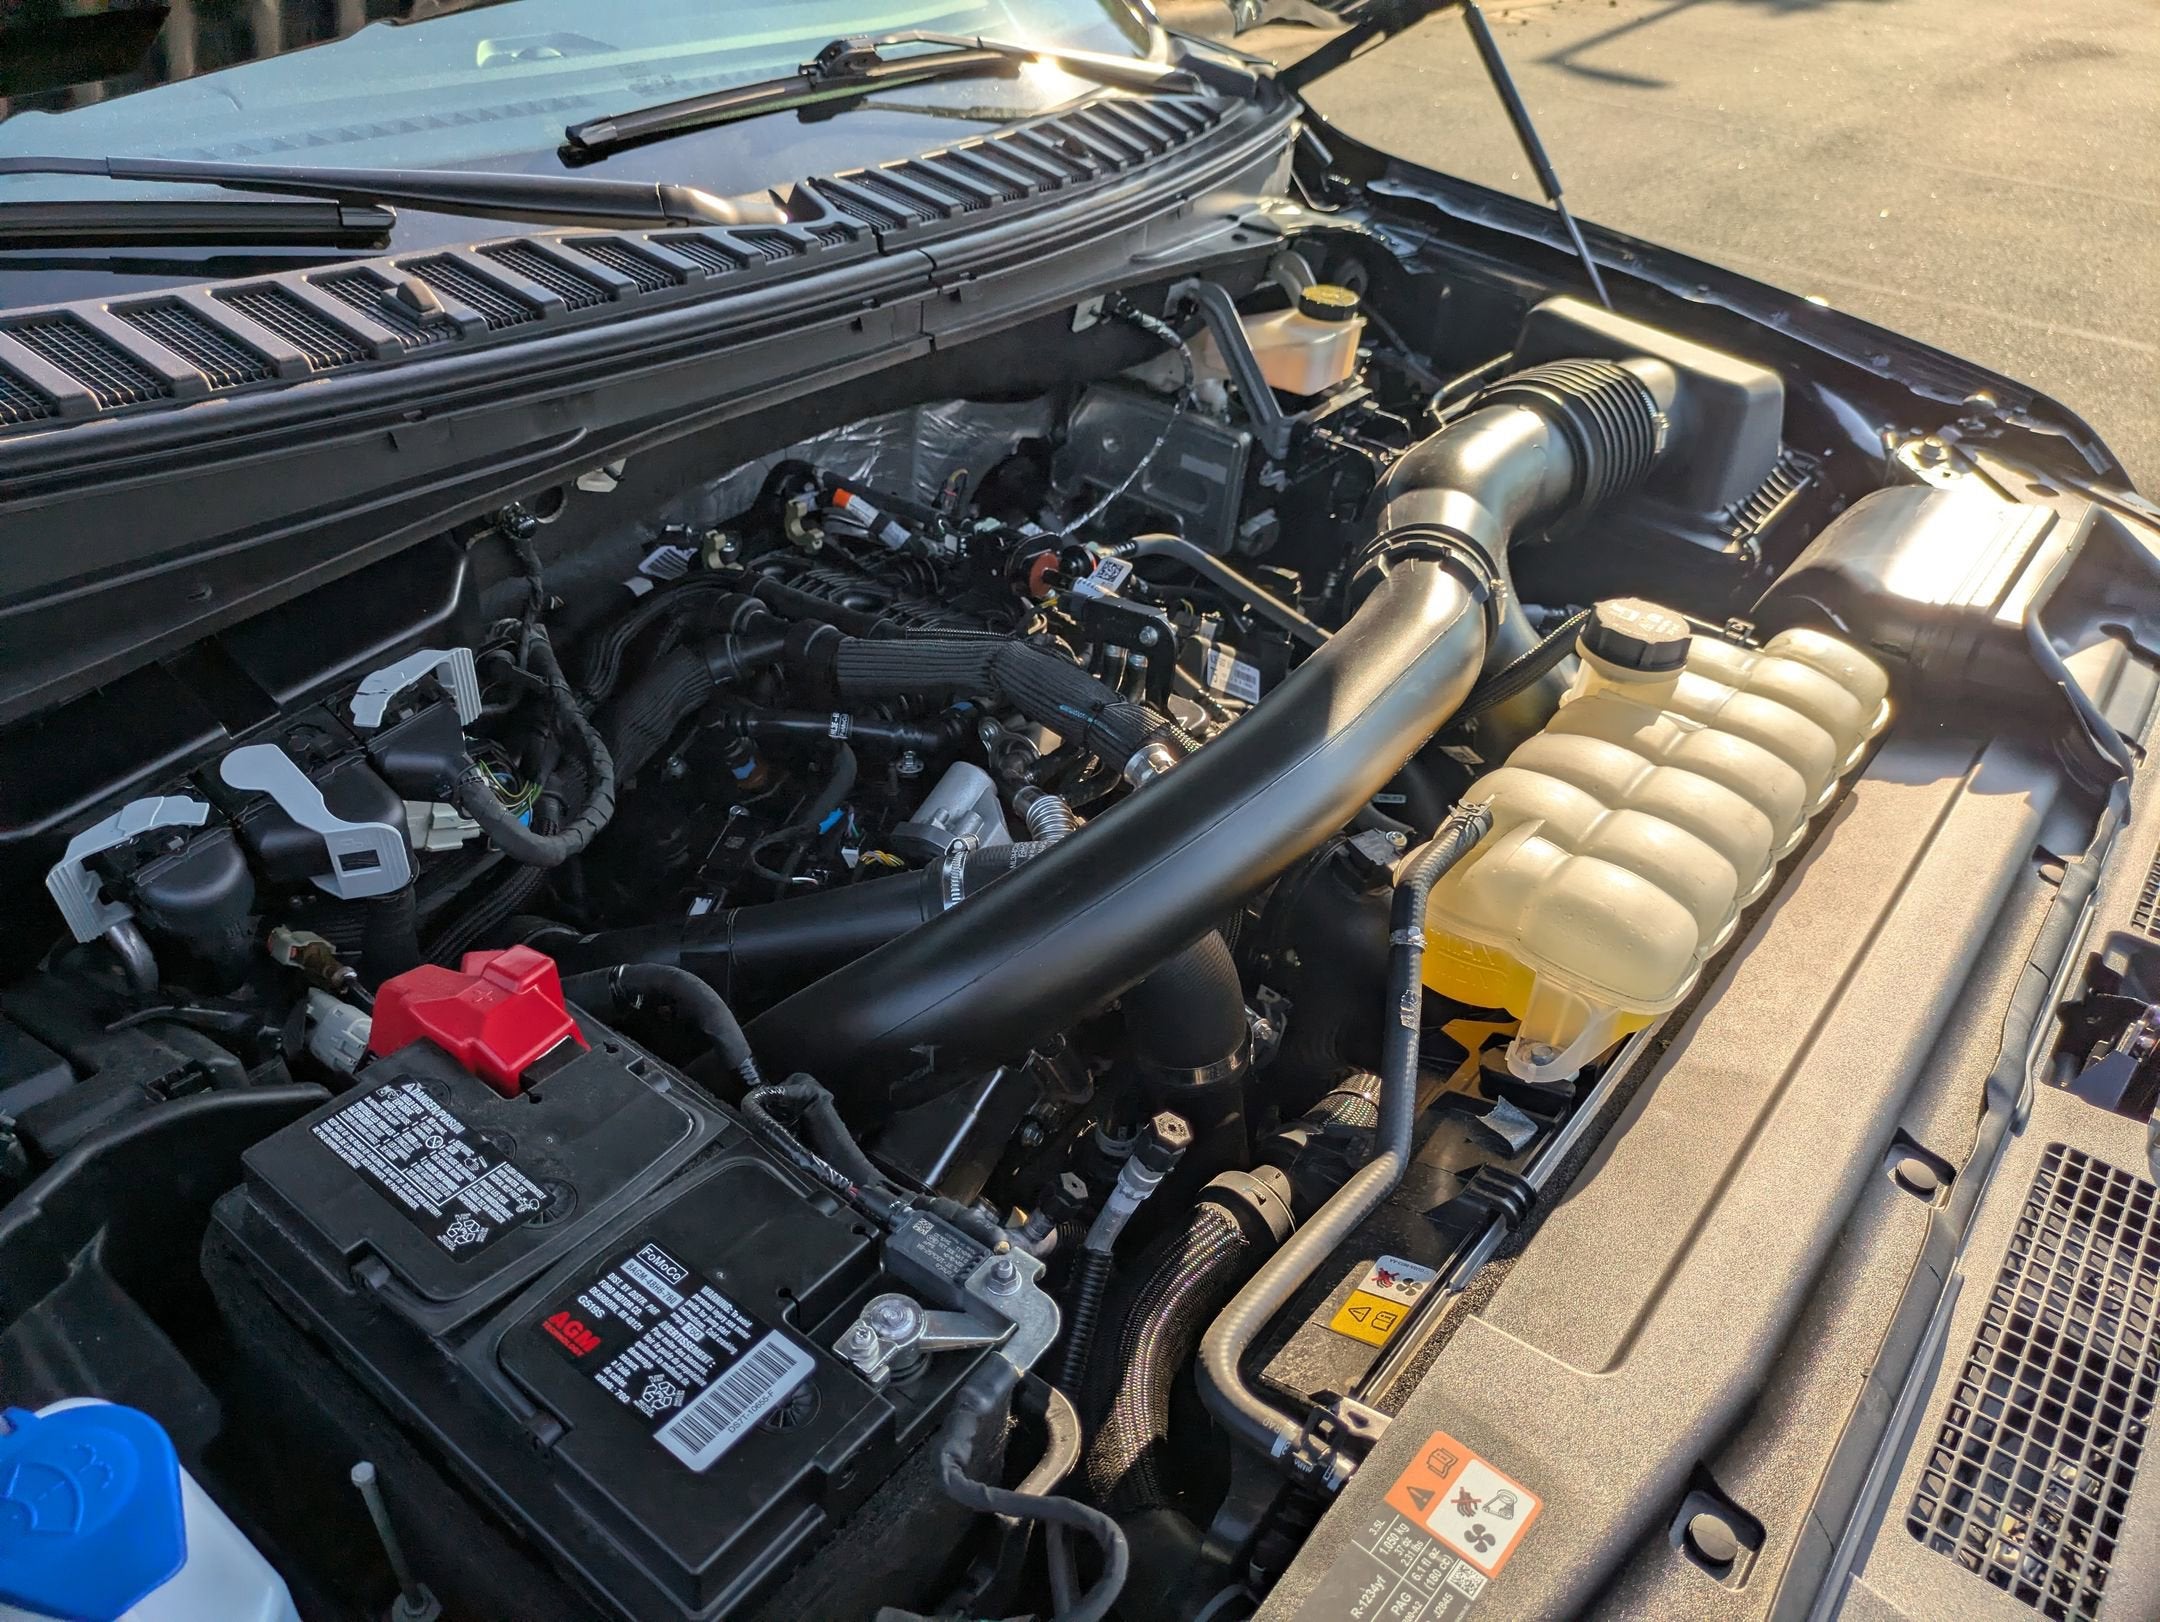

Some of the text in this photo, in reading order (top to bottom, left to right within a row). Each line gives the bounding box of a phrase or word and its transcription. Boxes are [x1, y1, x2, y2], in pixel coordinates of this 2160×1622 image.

[409, 1087, 465, 1134] DANGER/POISON
[639, 1247, 681, 1280] FoMoCo
[589, 1286, 620, 1313] DEARBORN,
[700, 1285, 733, 1313] WARNING:
[549, 1312, 600, 1351] AGM
[1350, 1574, 1386, 1619] R-1234yf
